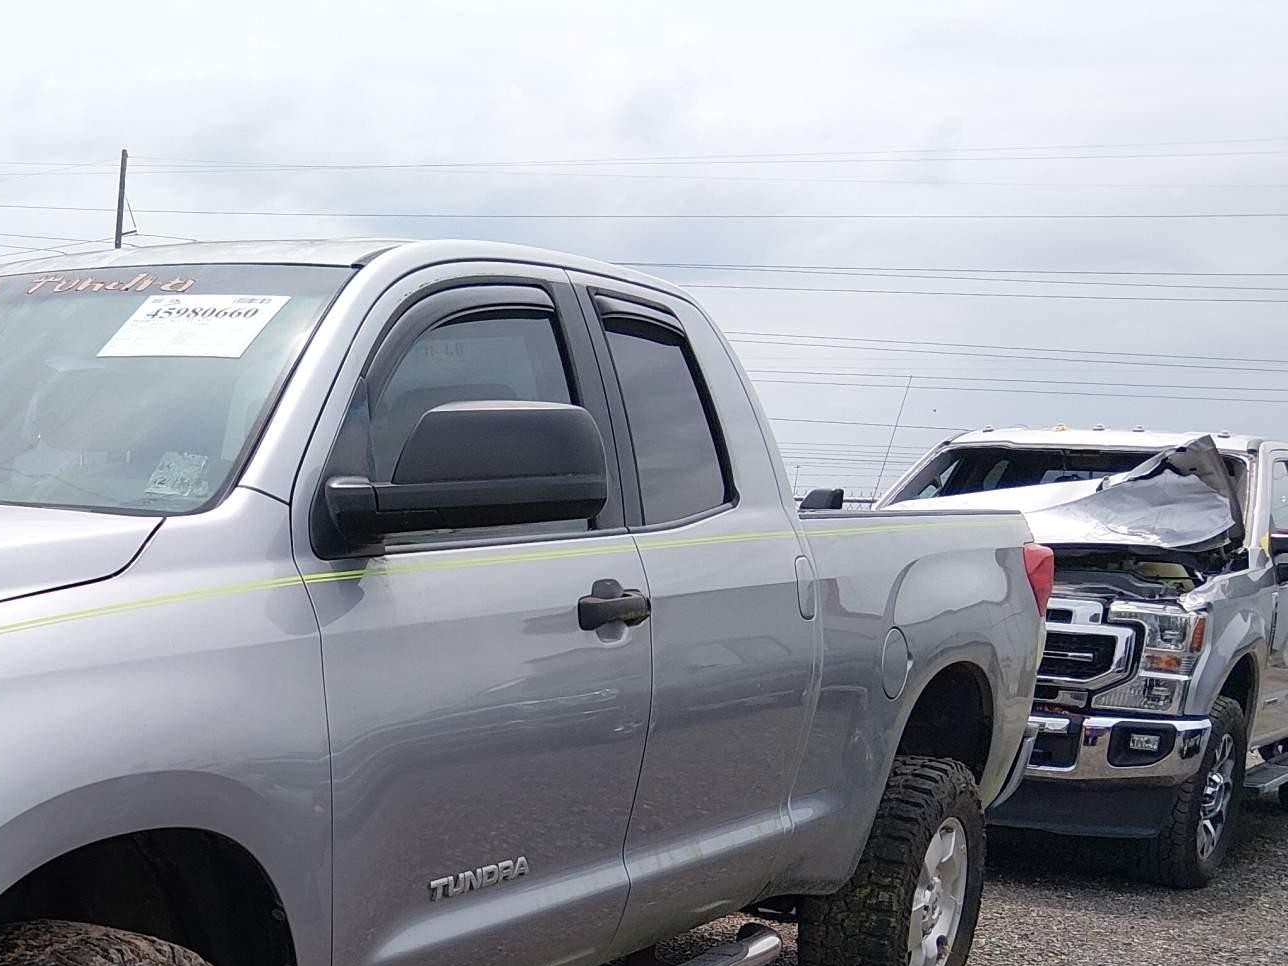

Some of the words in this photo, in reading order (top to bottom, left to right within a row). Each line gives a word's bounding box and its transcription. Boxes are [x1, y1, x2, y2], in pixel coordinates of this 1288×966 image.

[26, 272, 196, 294] Tundra
[146, 306, 260, 319] 45980660
[429, 855, 529, 901] TUNDRA
